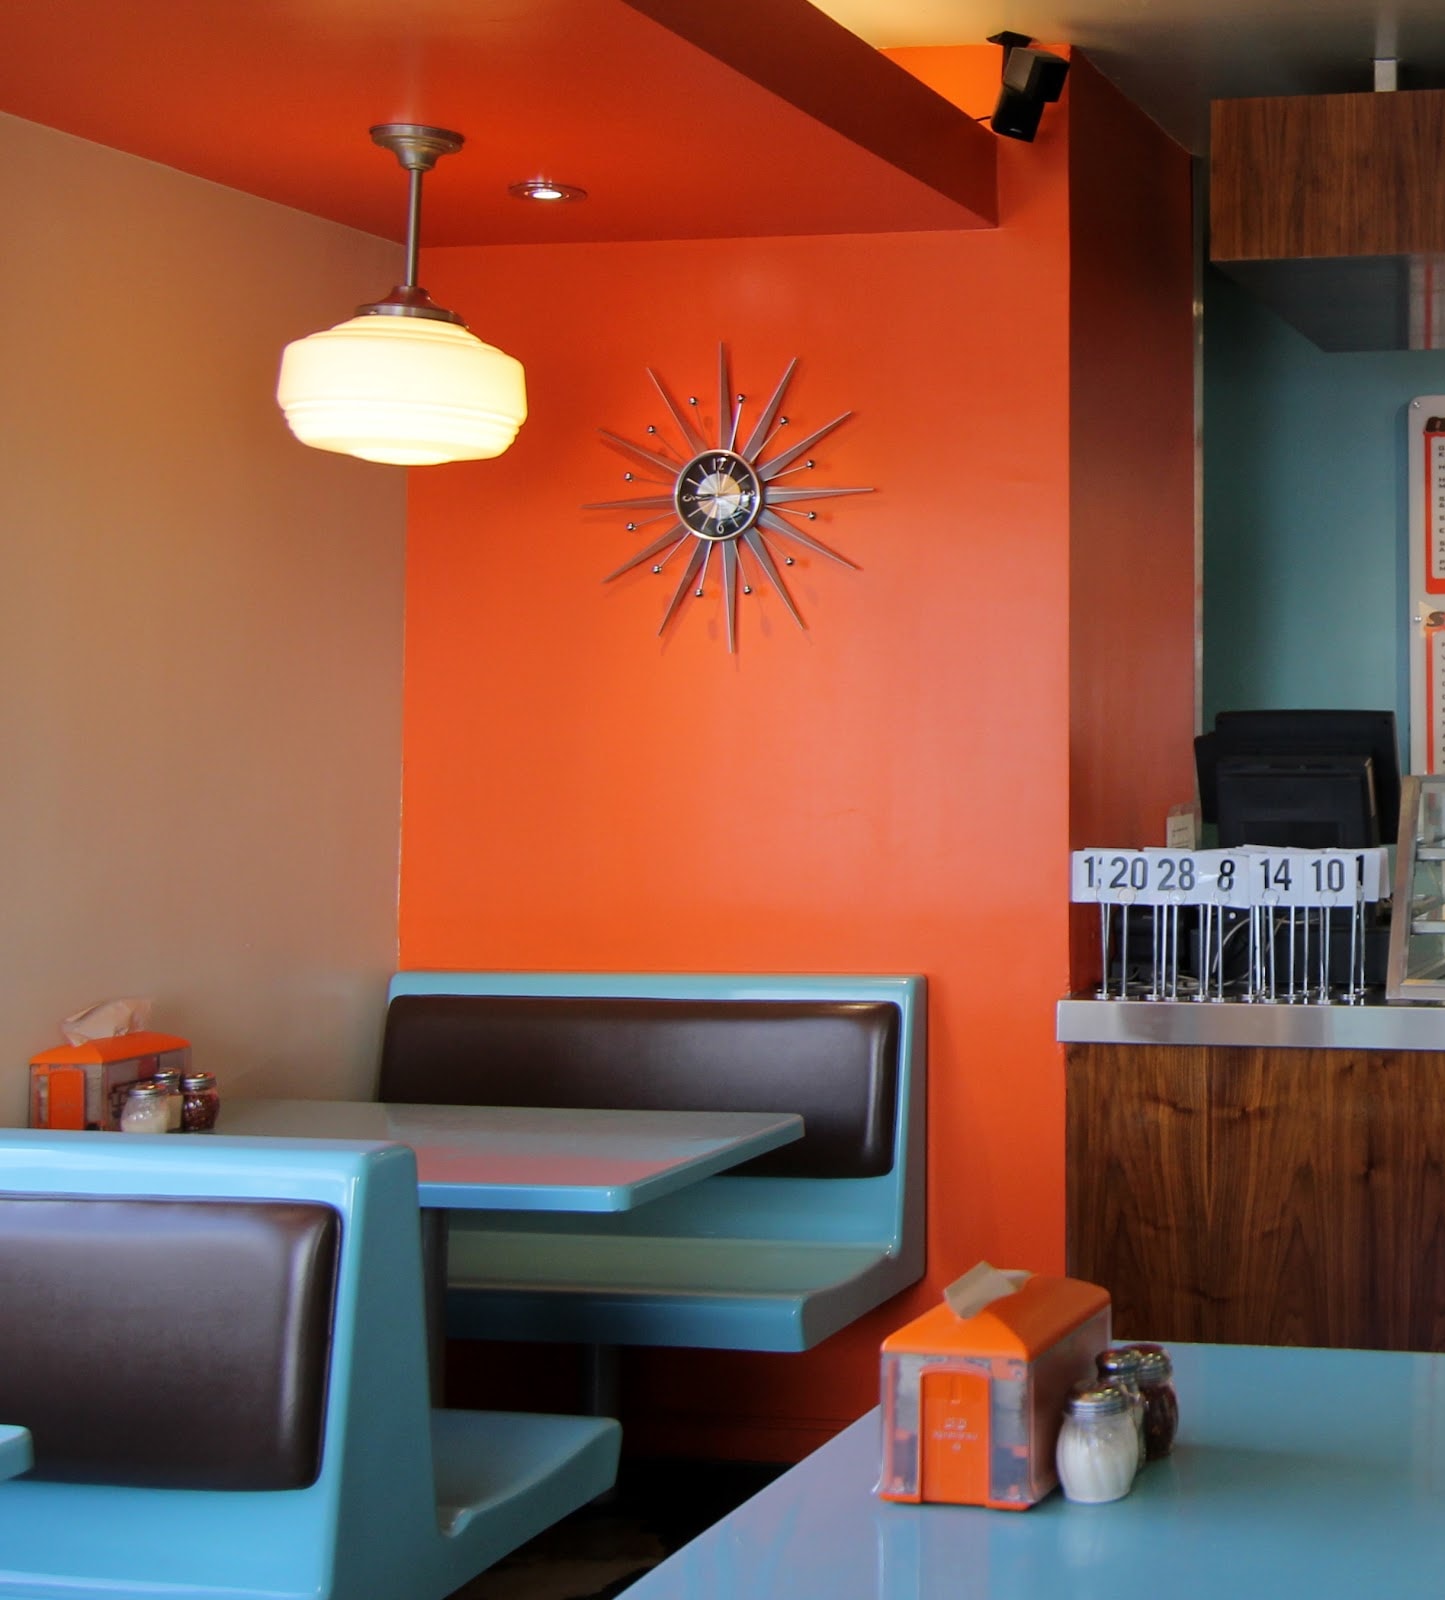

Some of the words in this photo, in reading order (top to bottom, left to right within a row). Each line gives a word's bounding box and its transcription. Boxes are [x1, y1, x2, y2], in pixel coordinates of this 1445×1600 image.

[712, 458, 727, 471] 12
[716, 522, 724, 534] 6
[1110, 856, 1148, 890] 20
[1158, 857, 1195, 891] 28
[1217, 859, 1235, 891] 8
[1260, 858, 1292, 891] 14
[1311, 858, 1344, 892] 10
